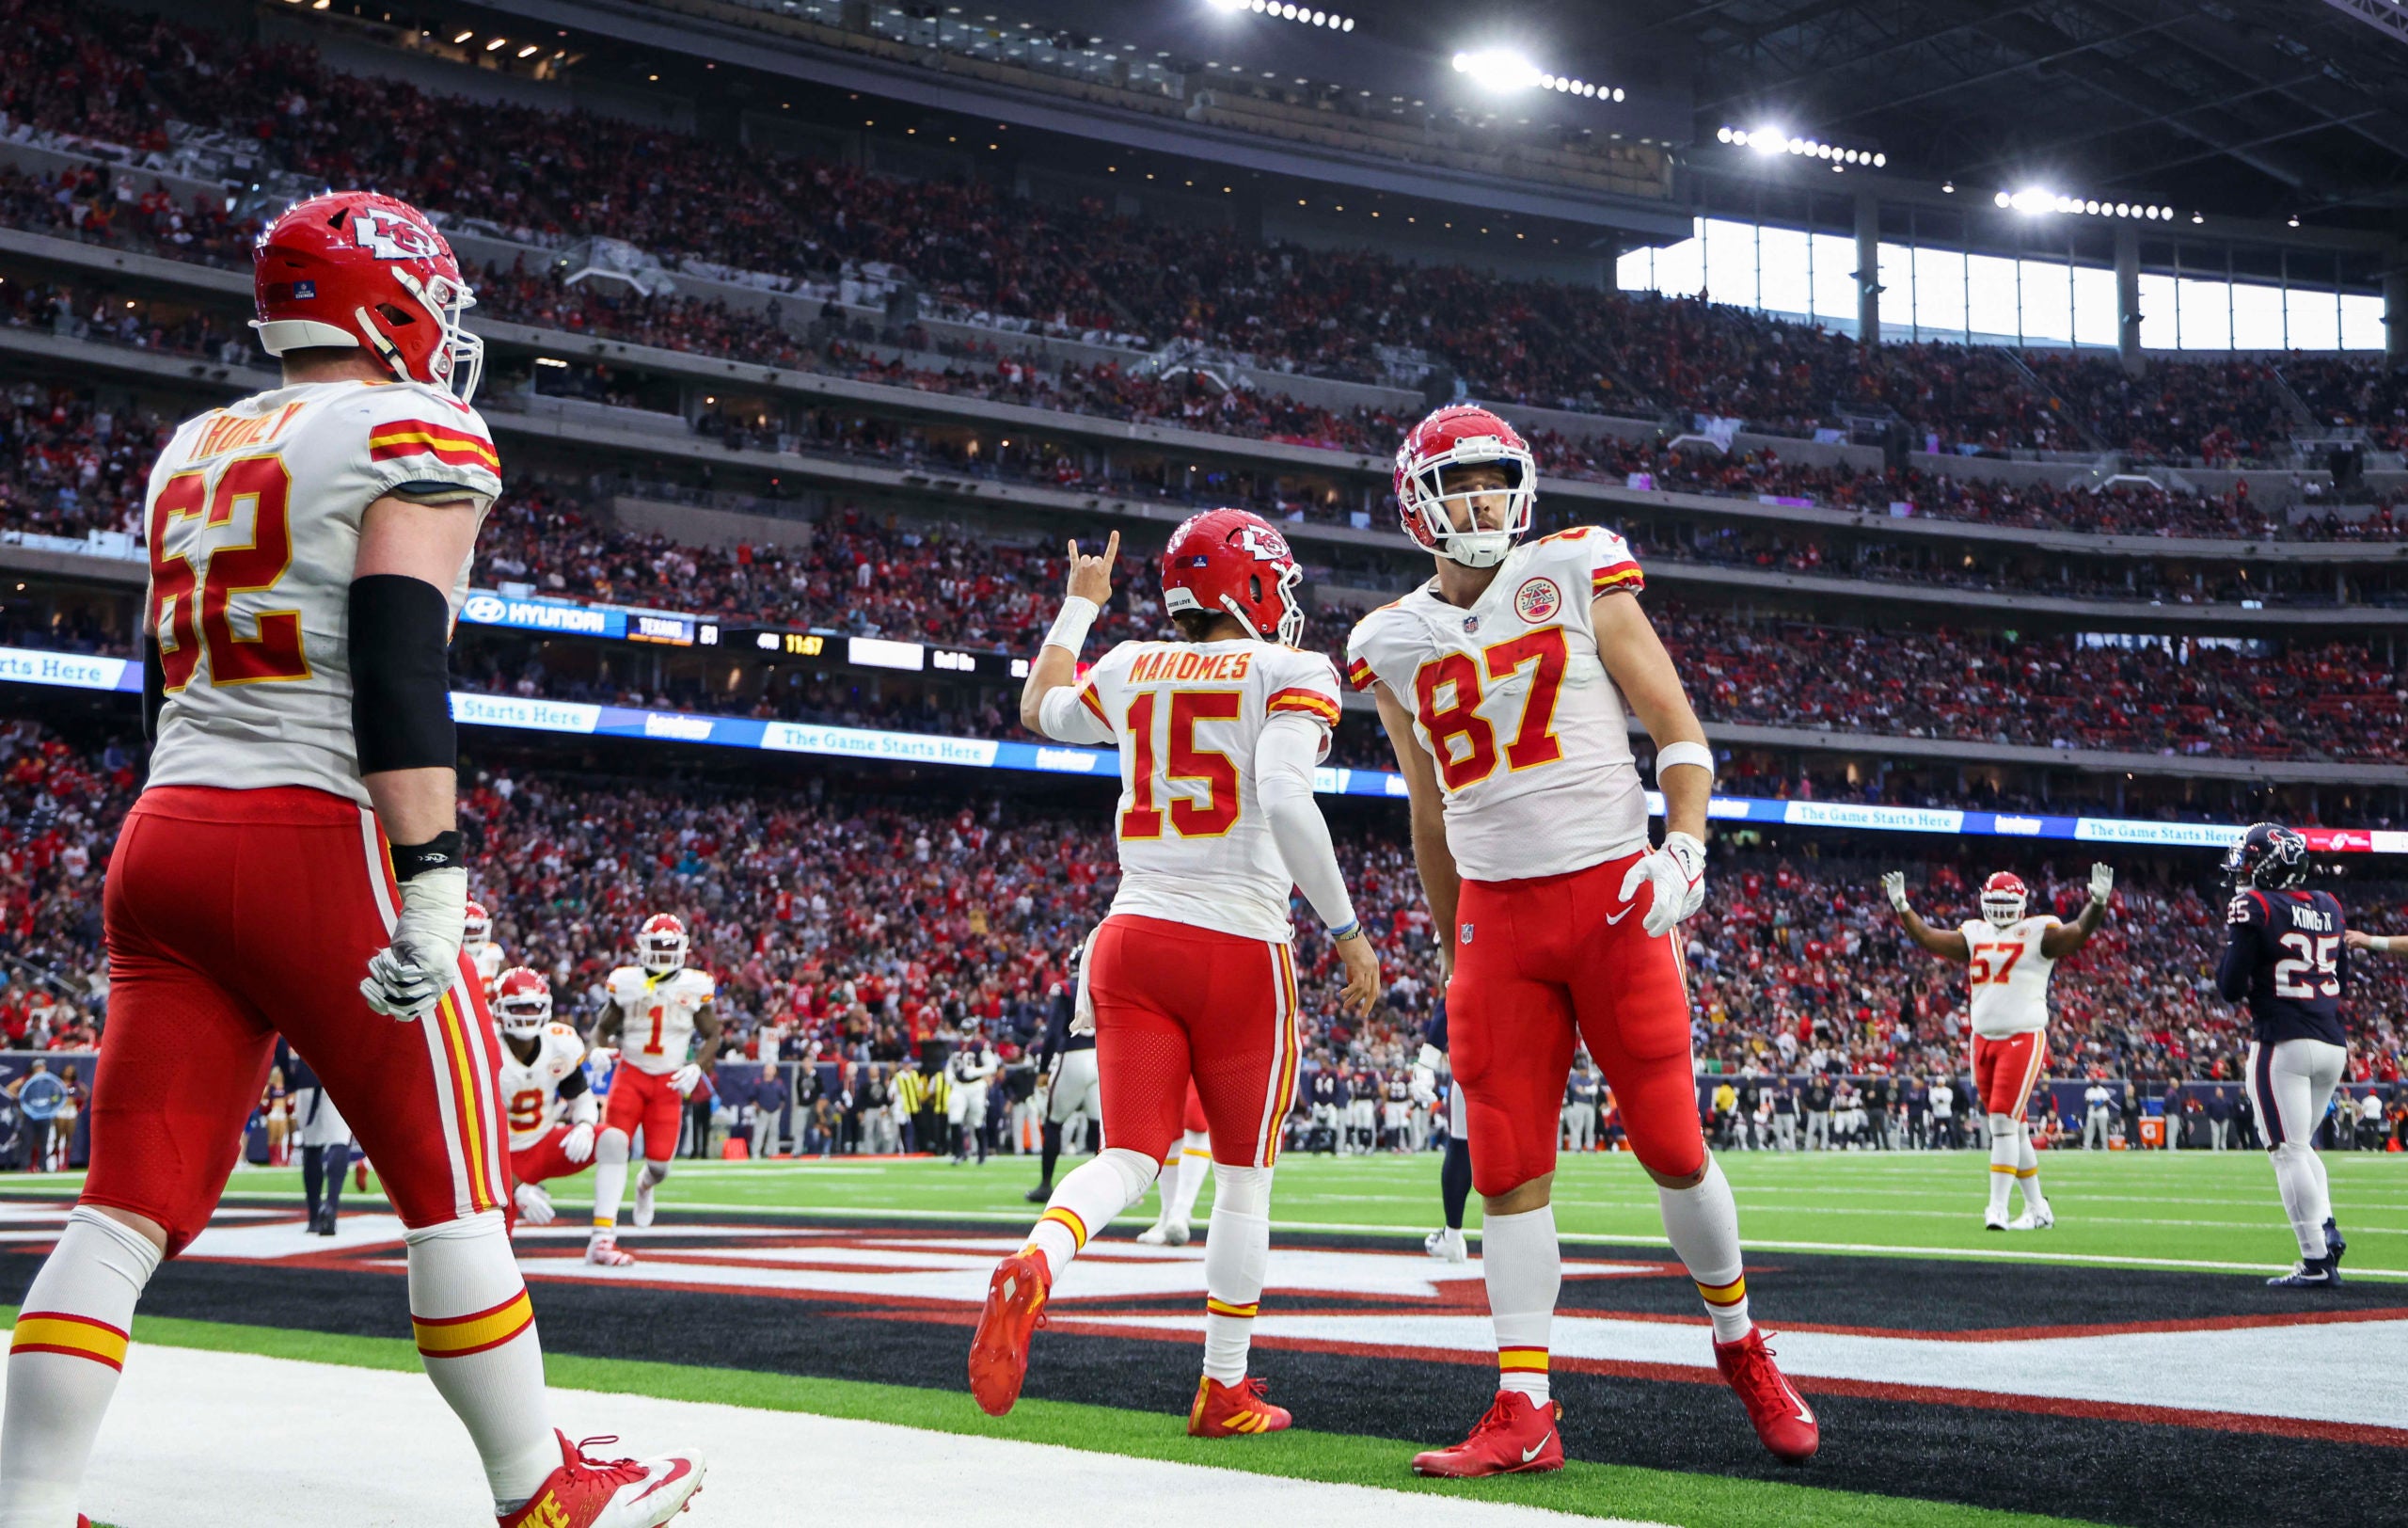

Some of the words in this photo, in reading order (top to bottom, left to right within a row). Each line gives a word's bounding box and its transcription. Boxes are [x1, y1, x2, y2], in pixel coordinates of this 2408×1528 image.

[187, 402, 308, 462] THUNEY
[150, 454, 312, 698] 62
[509, 601, 605, 632] HYUNDAI
[0, 658, 32, 676] rts
[41, 660, 101, 681] Here
[1128, 651, 1253, 685] MAHOMES
[464, 700, 526, 721] Starts
[532, 706, 581, 725] Here
[1415, 624, 1570, 793] 87
[784, 729, 818, 746] The
[823, 732, 876, 751] Game
[882, 737, 934, 756] Starts
[941, 743, 982, 760] Here
[1119, 690, 1243, 841] 15
[1800, 805, 1826, 820] The
[1830, 806, 1869, 823] Game
[1874, 811, 1915, 825] Starts
[1919, 814, 1952, 827] Here
[2090, 823, 2115, 836] The
[2118, 825, 2157, 838] Game
[2162, 828, 2201, 840] Starts
[2205, 830, 2236, 842] Here
[2226, 899, 2251, 925] 25
[2291, 904, 2322, 931] KING
[1970, 943, 2024, 984] 57
[2274, 931, 2341, 999] 25
[643, 1004, 665, 1057] 1
[509, 1088, 544, 1133] 9
